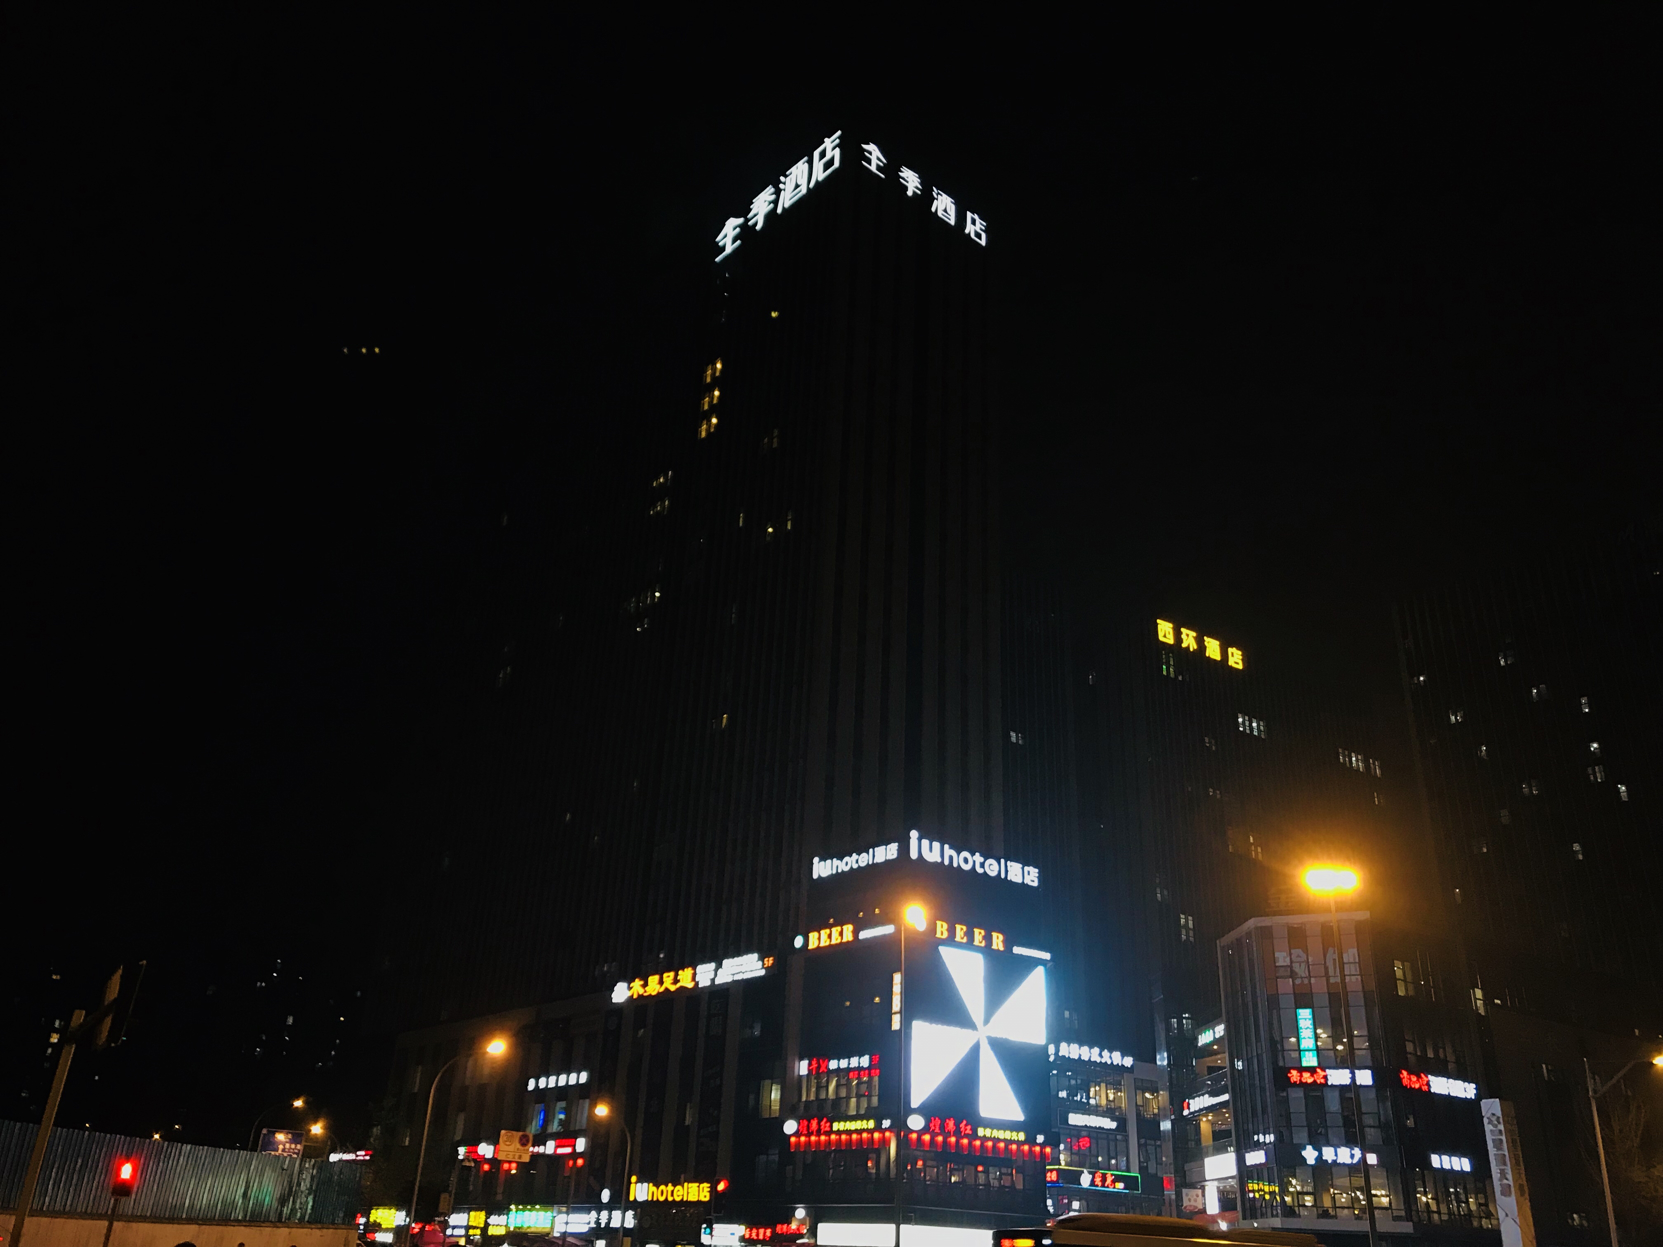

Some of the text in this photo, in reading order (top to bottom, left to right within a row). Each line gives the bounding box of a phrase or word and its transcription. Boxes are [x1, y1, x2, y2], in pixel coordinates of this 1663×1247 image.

[715, 129, 842, 262] 全季酒店
[861, 142, 987, 247] 全季酒店
[1156, 618, 1243, 670] 西环酒店
[807, 923, 855, 950] BEER
[935, 920, 1006, 951] BEER
[628, 966, 695, 999] 木易足道
